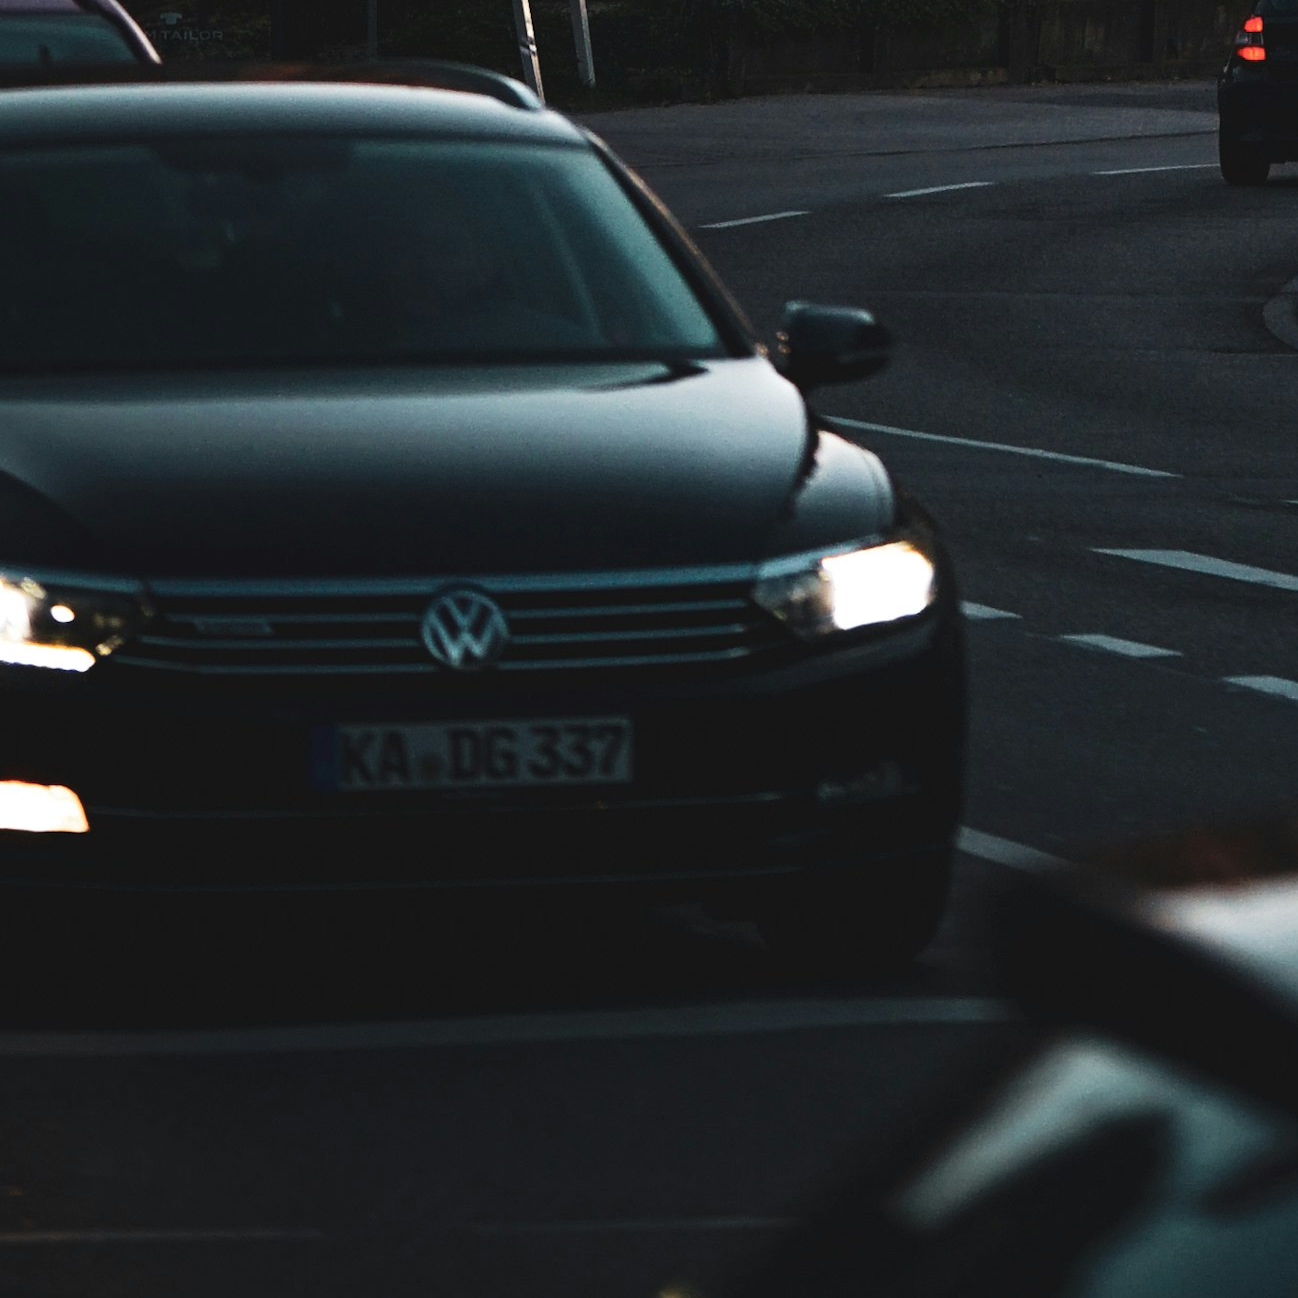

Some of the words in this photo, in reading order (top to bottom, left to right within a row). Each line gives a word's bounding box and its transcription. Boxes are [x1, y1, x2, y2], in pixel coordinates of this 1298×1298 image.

[161, 30, 224, 41] TAILOR
[339, 731, 409, 784] KA
[447, 728, 516, 780] DG
[528, 724, 625, 777] 337
